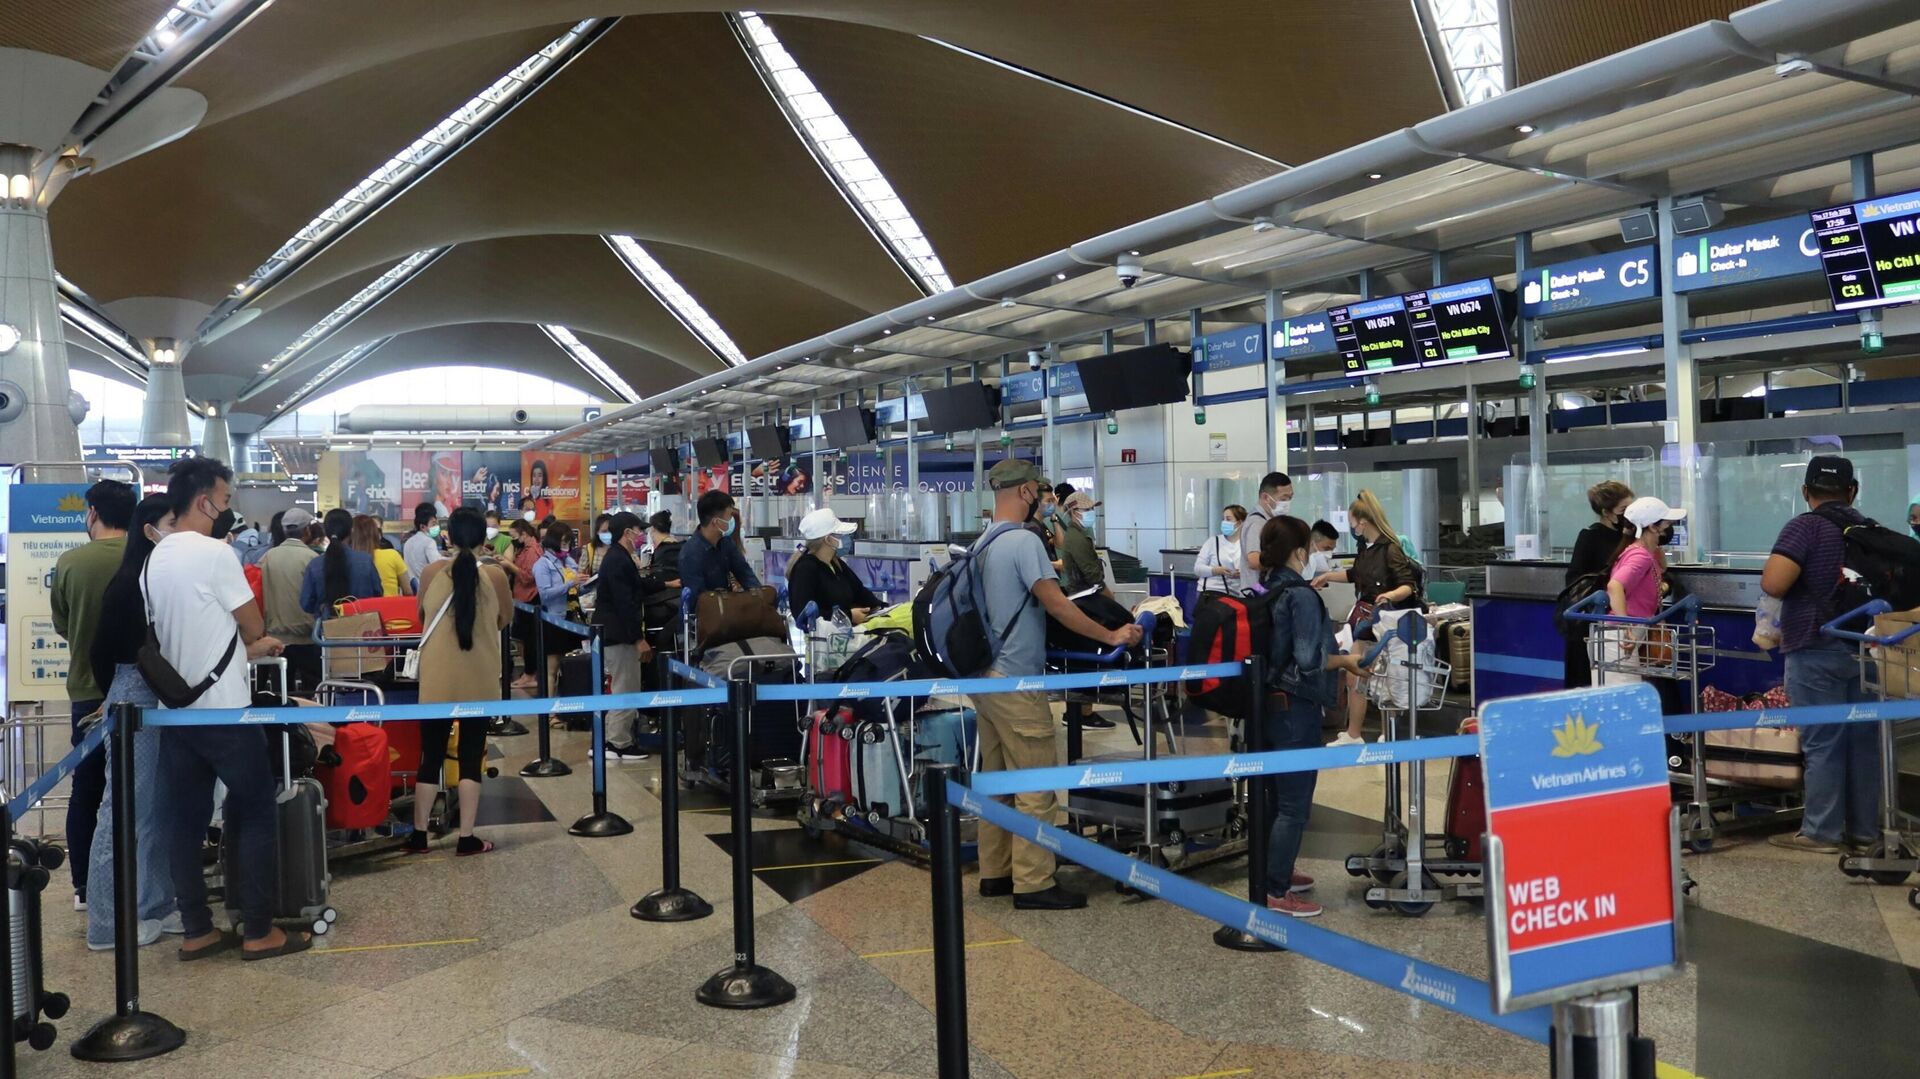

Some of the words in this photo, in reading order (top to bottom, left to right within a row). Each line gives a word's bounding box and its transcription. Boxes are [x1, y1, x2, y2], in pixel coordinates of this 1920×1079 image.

[1889, 220, 1915, 237] VN
[1745, 235, 1780, 253] Masuk
[1875, 260, 1893, 271] Ho
[1893, 255, 1914, 268] Chi
[1619, 259, 1649, 288] C5
[1841, 284, 1864, 297] C31
[1446, 304, 1460, 315] VN
[1460, 301, 1481, 314] 0674
[1365, 319, 1377, 330] VN
[1441, 332, 1451, 340] Ho
[1451, 330, 1462, 338] Chi
[1462, 327, 1477, 337] Minh
[1477, 326, 1490, 335] City
[1244, 334, 1260, 354] C7
[1425, 348, 1438, 358] C31
[1032, 377, 1042, 392] C9
[936, 481, 966, 493] YOU
[31, 514, 74, 525] Vietnam
[32, 642, 36, 650] 2
[1532, 769, 1583, 791] Vietnam
[1583, 764, 1627, 784] Airlines
[1509, 876, 1561, 907] WEB
[1511, 898, 1589, 935] CHECK
[1595, 893, 1616, 918] IN
